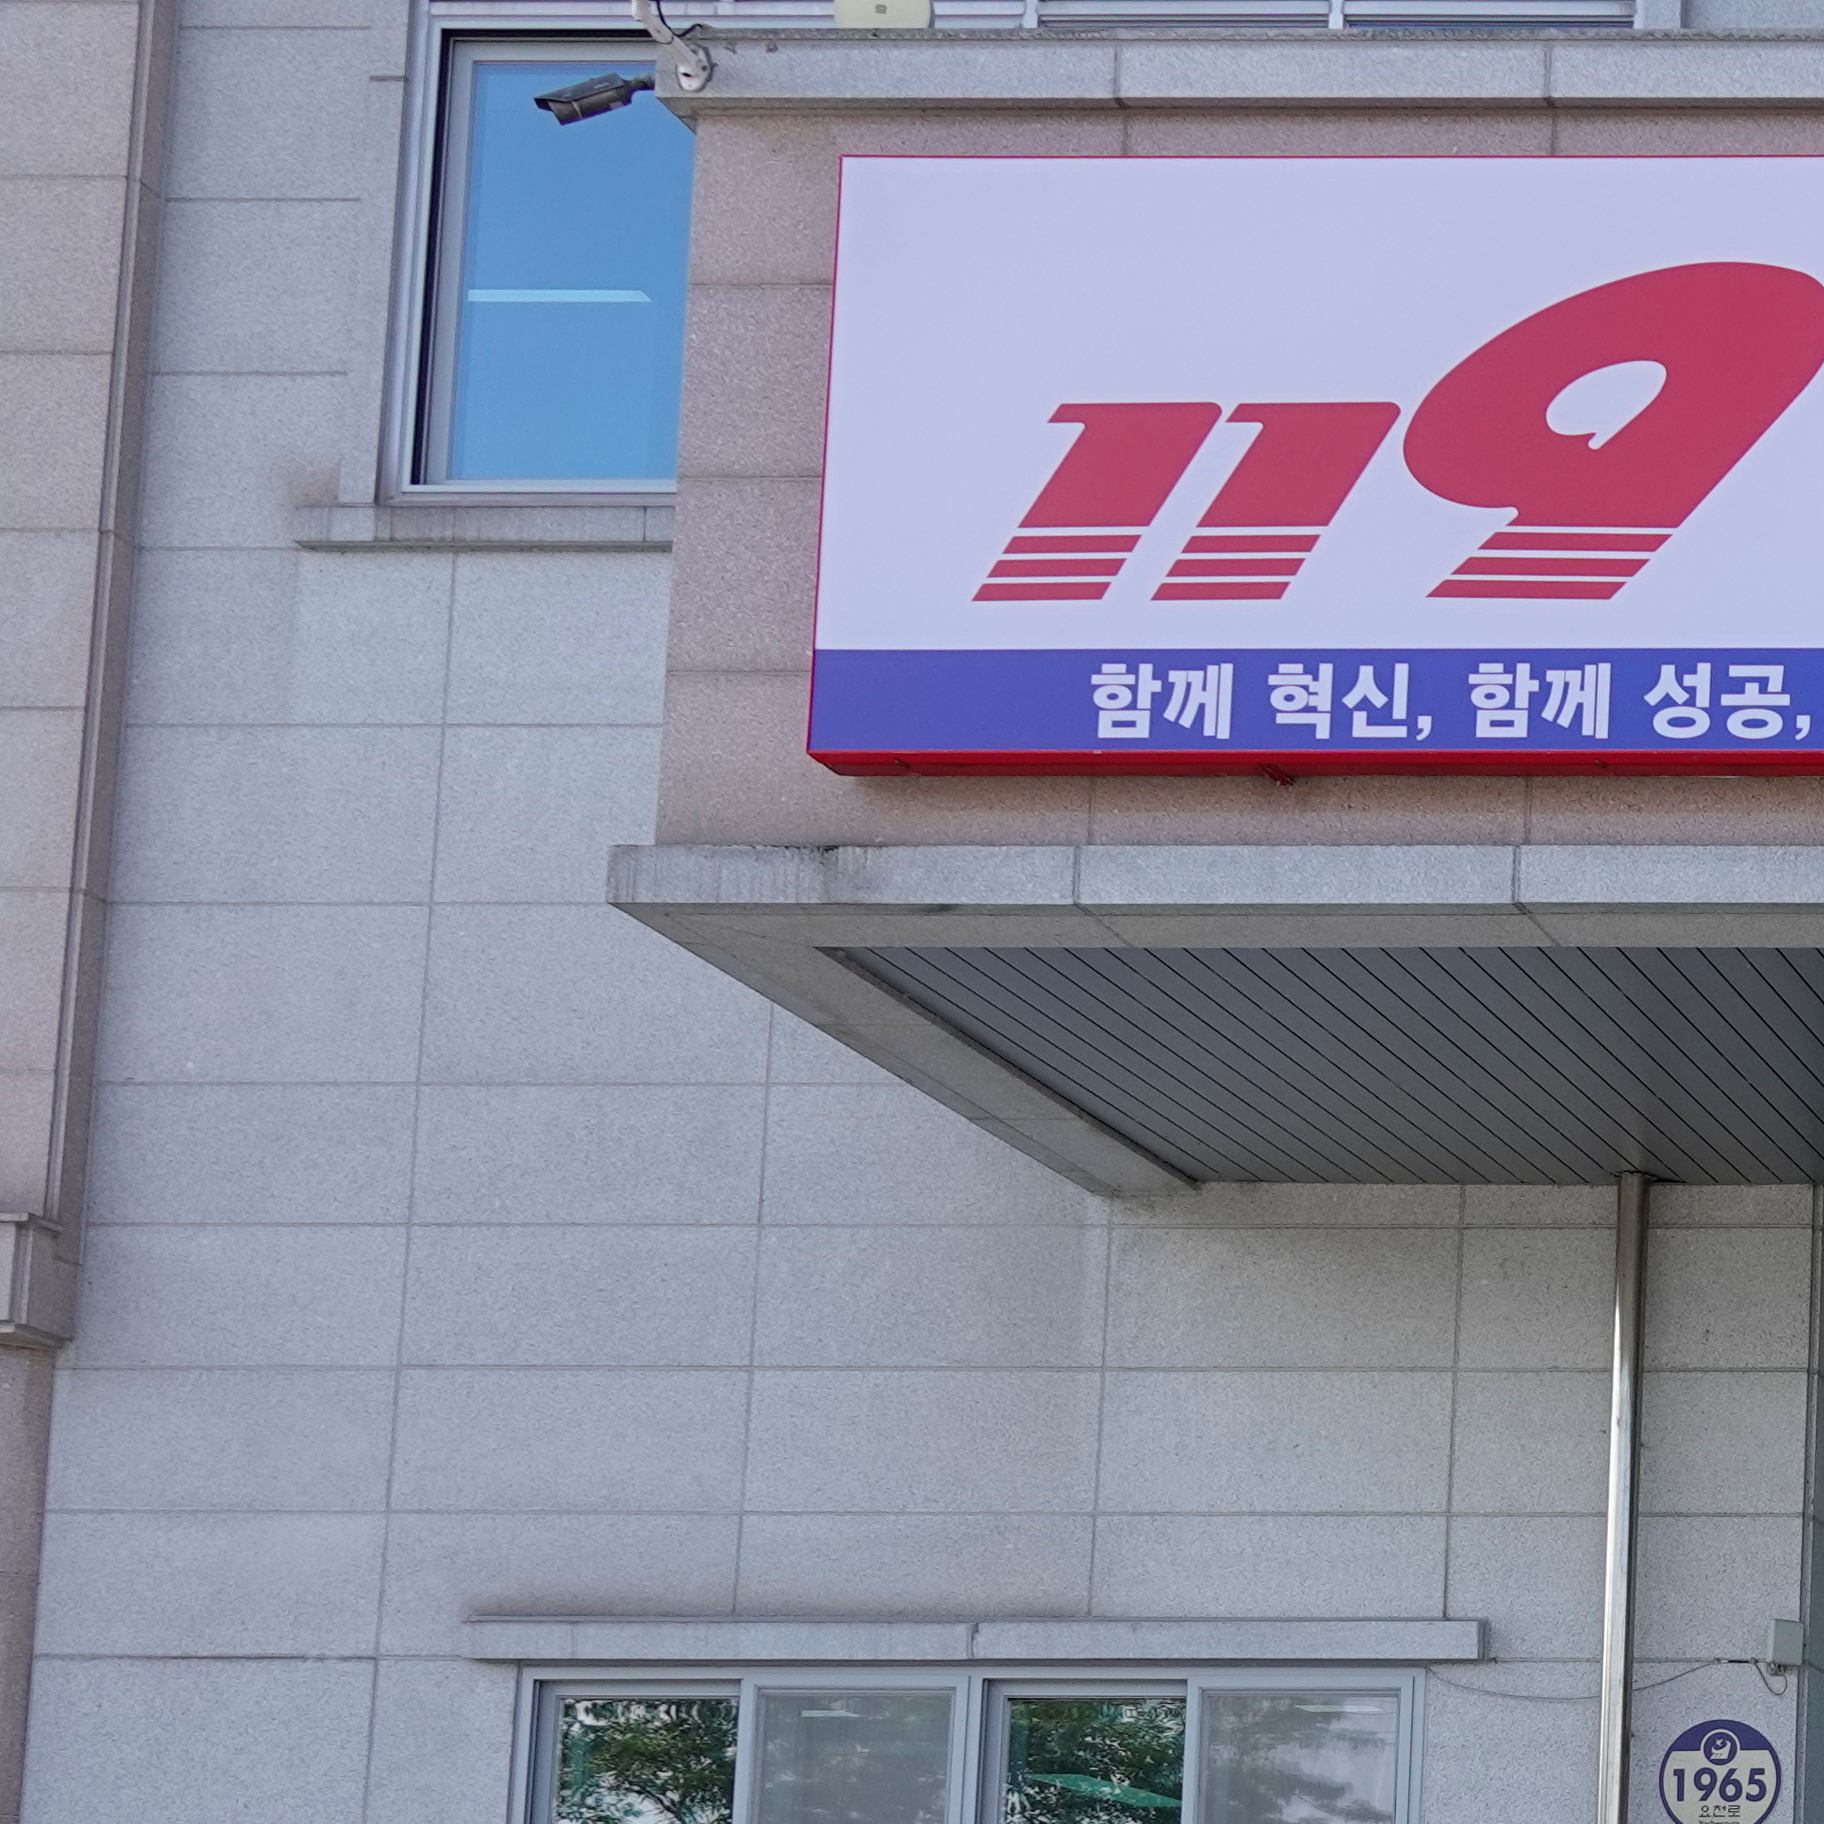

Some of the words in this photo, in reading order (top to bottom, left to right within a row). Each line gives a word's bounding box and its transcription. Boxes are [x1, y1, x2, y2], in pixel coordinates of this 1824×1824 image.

[1091, 663, 1236, 741] 함께
[1268, 663, 1433, 742] 혁신,
[1468, 663, 1612, 741] 함께
[1644, 663, 1811, 742] 성공,
[1673, 1767, 1767, 1802] 1965
[1698, 1804, 1741, 1818] 요천로
